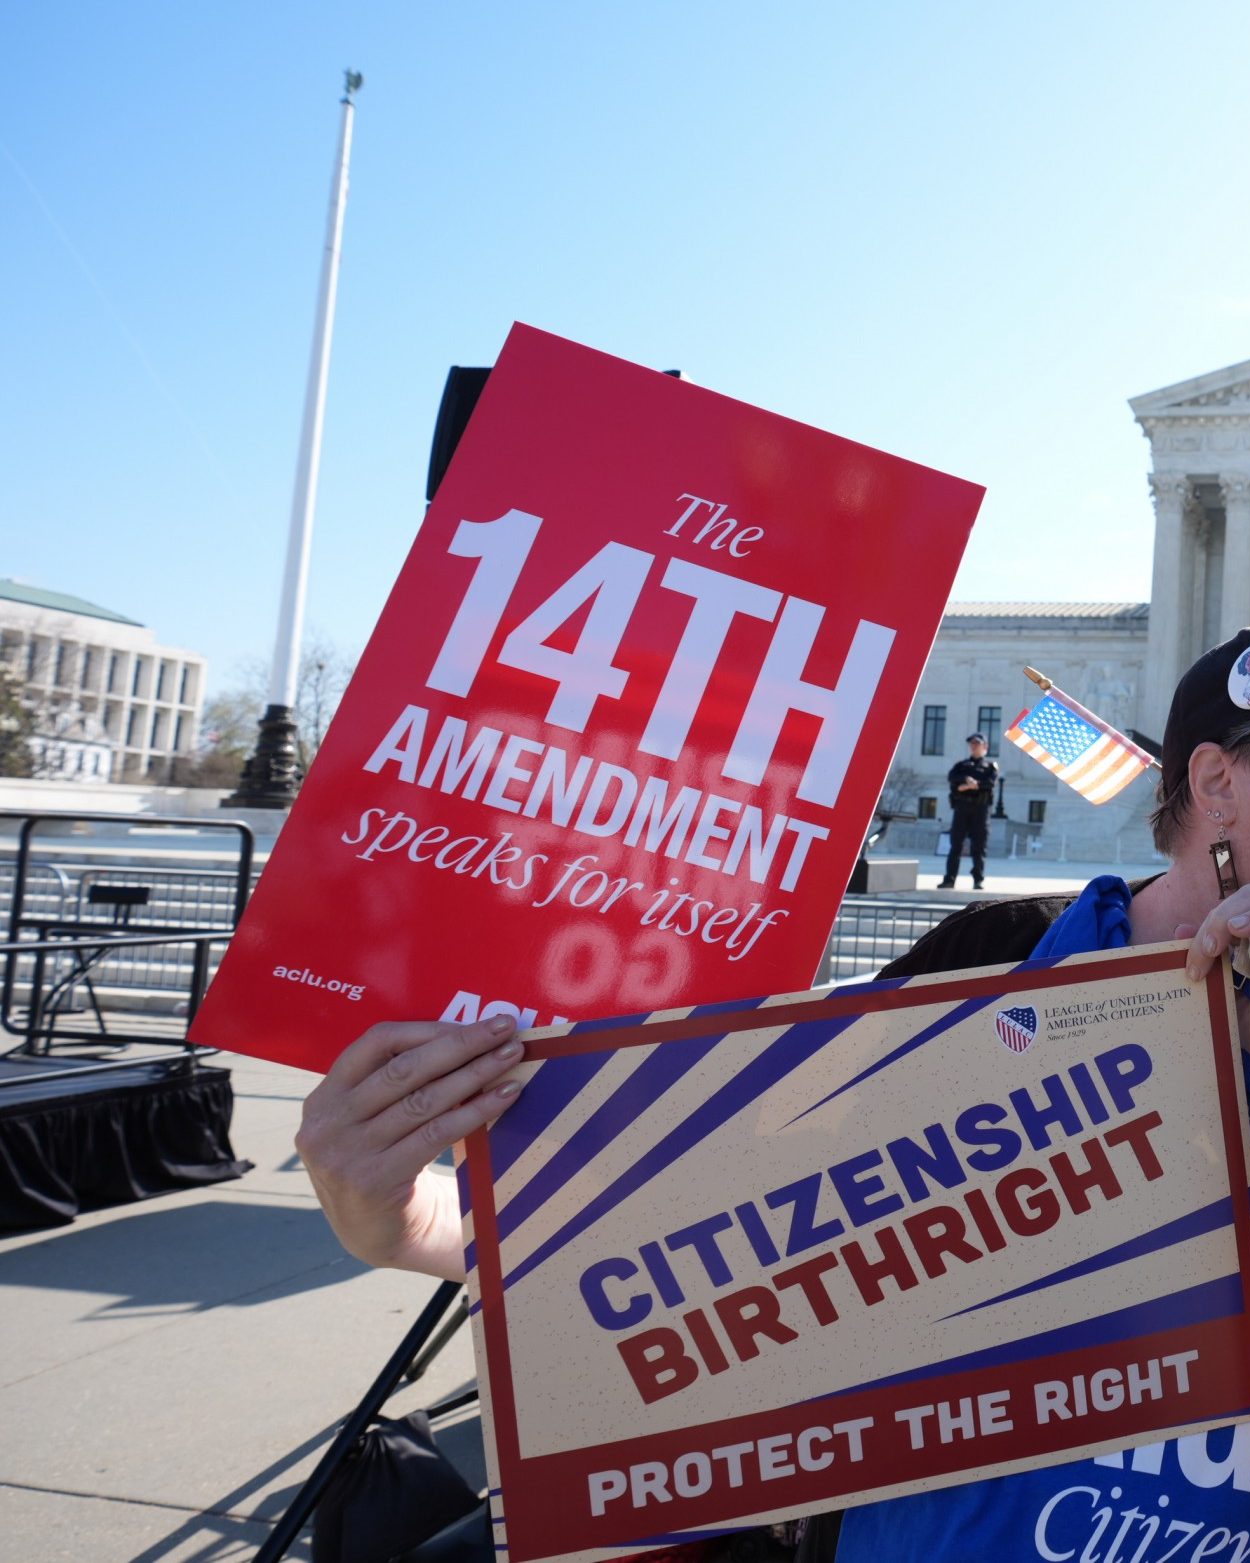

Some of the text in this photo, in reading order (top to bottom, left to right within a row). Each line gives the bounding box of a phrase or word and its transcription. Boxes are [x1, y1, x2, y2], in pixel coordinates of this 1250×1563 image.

[663, 493, 765, 558] The
[425, 507, 898, 809] 14TH
[362, 704, 831, 894] AMENDMENT
[341, 808, 548, 890] speaks
[532, 855, 641, 914] for
[640, 877, 790, 962] itself
[272, 965, 367, 1001] aclu.org
[1045, 987, 1192, 1018] LEAGUE of UNITED LATIN
[1046, 1004, 1165, 1031] AMERICAN CITIZENS
[578, 1042, 1154, 1333] CITIZENSHIP
[616, 1110, 1165, 1405] BIRTHRIGHT
[587, 1349, 1200, 1518] PROTECT THE RIGHT
